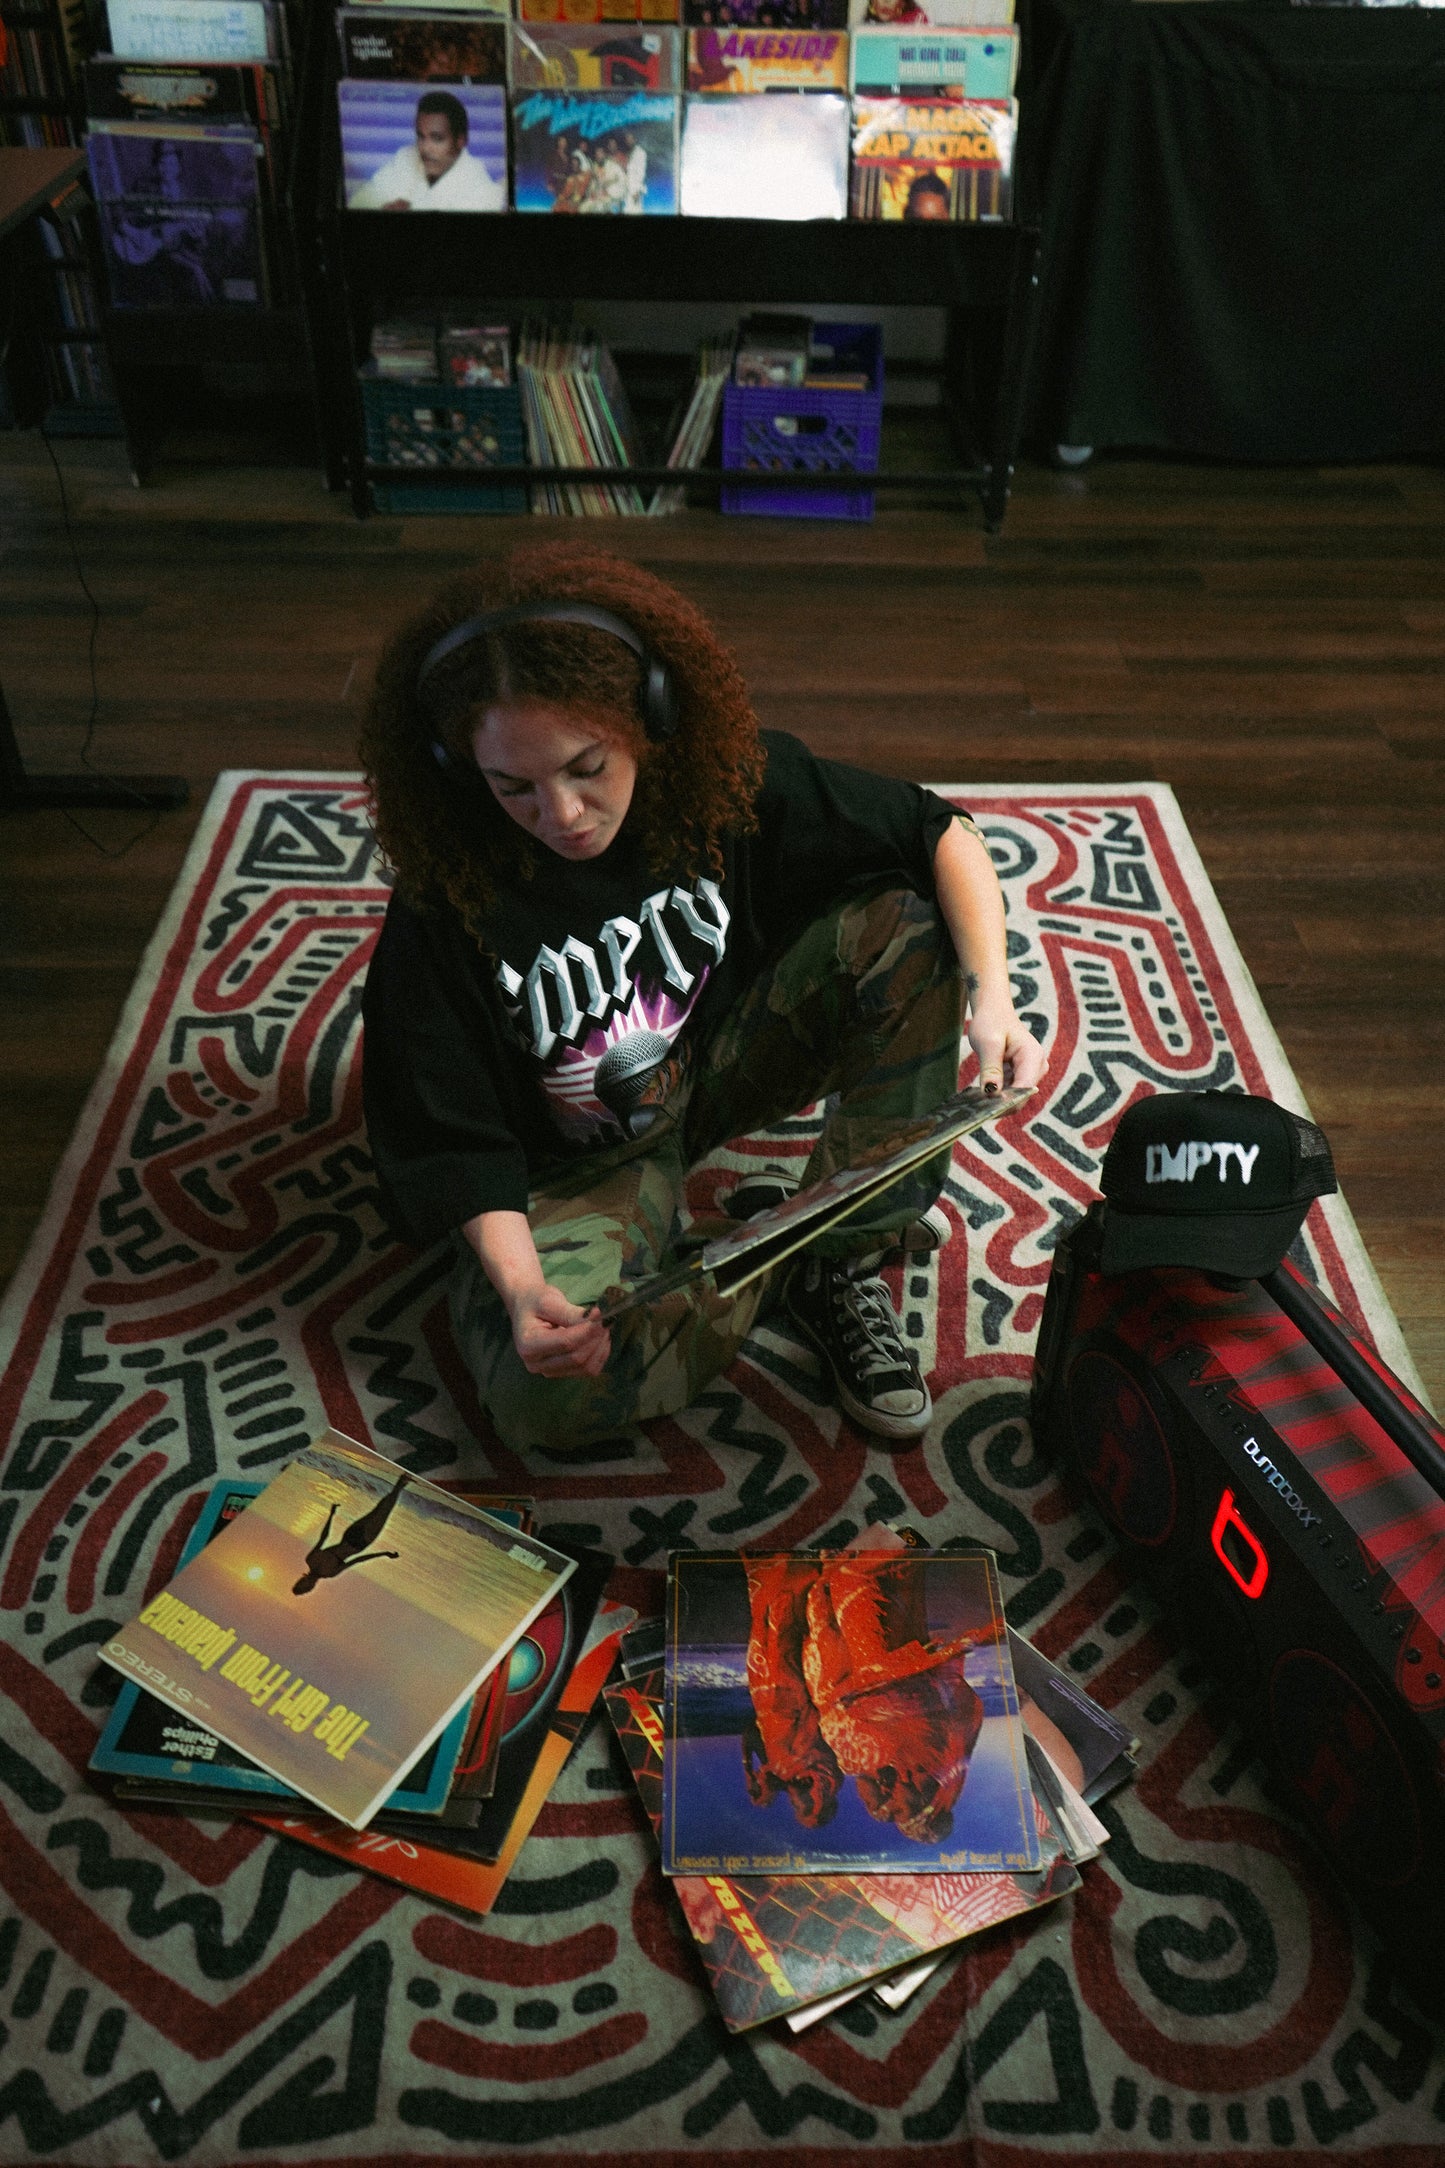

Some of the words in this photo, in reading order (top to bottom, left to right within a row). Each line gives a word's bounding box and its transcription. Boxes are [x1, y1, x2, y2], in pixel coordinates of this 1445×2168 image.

[1243, 1436, 1316, 1528] bumpboxx
[138, 1590, 238, 1673] Ipanema
[106, 1642, 195, 1705] STEREO
[219, 1642, 292, 1708] From
[267, 1677, 331, 1734] Girl
[160, 1740, 219, 1761] Esther
[313, 1703, 371, 1762] The
[729, 1911, 796, 1998] DAZZ
